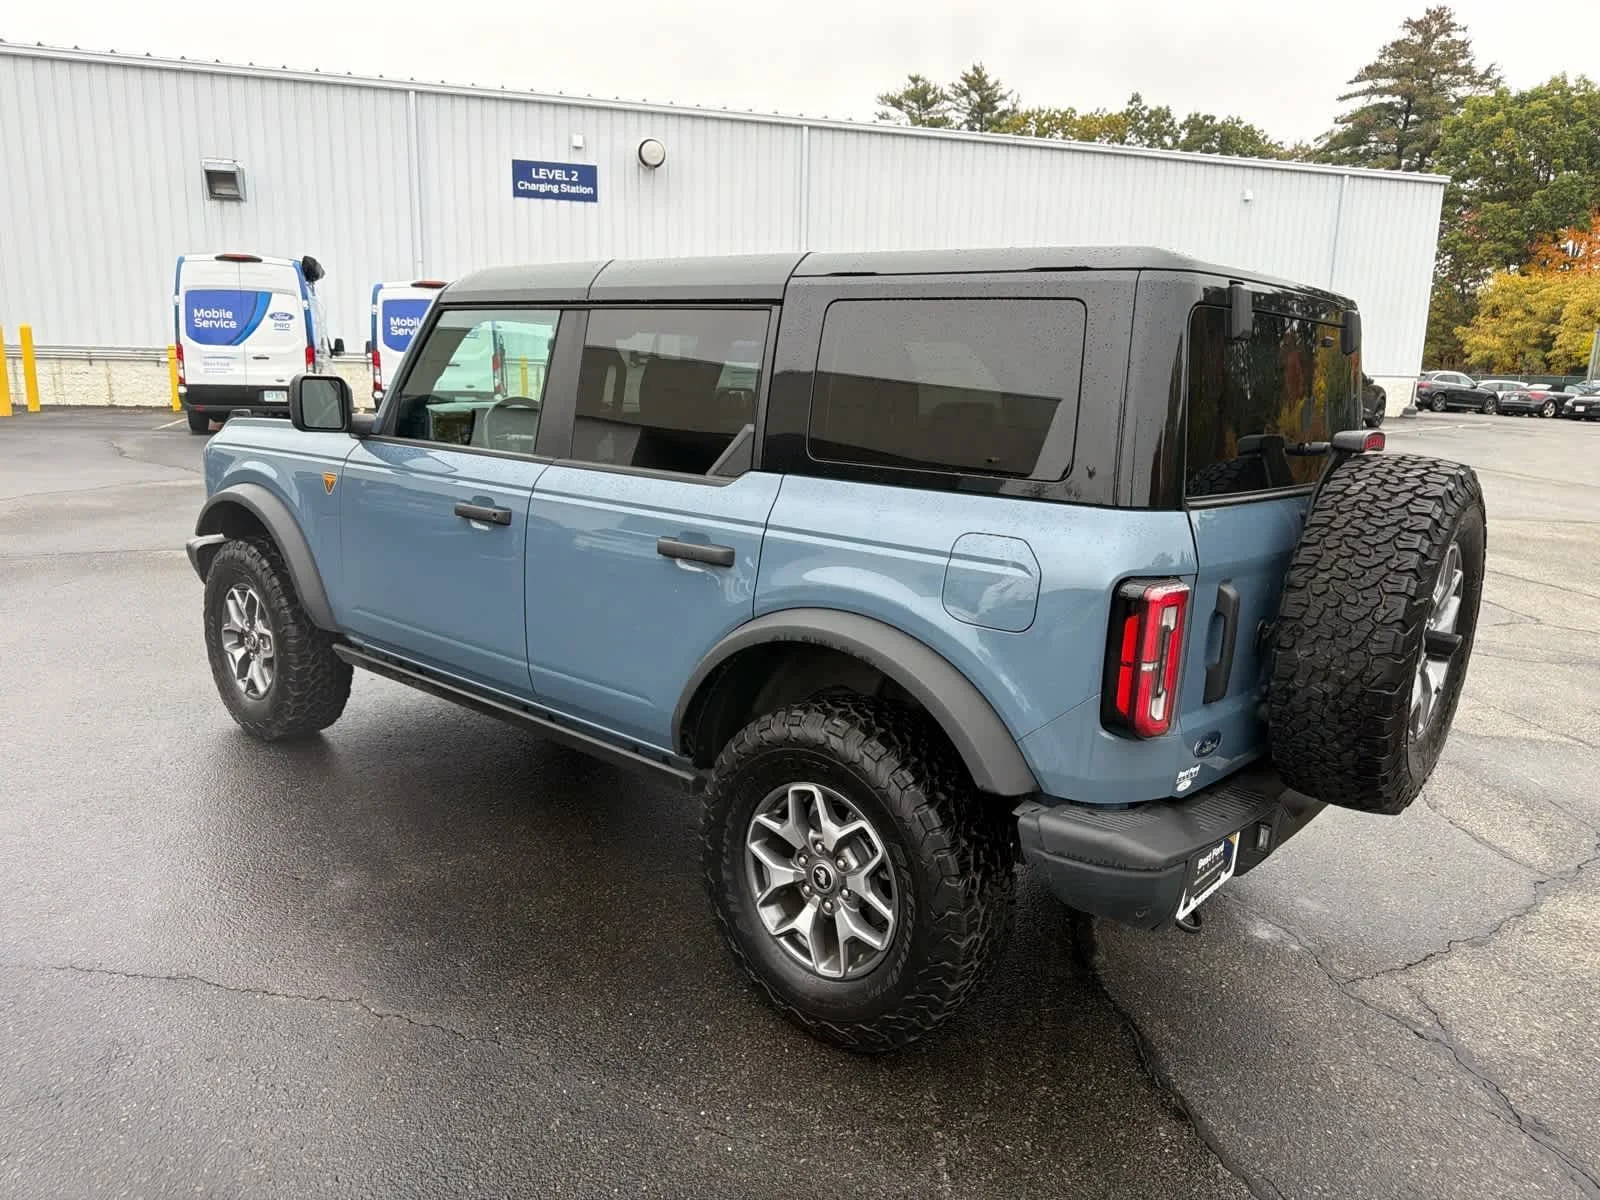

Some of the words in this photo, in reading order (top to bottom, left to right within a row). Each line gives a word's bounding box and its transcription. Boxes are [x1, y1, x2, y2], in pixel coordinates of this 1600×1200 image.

[531, 167, 570, 181] LEVEL
[571, 171, 579, 181] 2
[517, 180, 559, 194] Charging
[560, 184, 594, 195] Station
[193, 308, 233, 319] Mobile
[193, 318, 237, 329] Service
[390, 326, 416, 336] Serv
